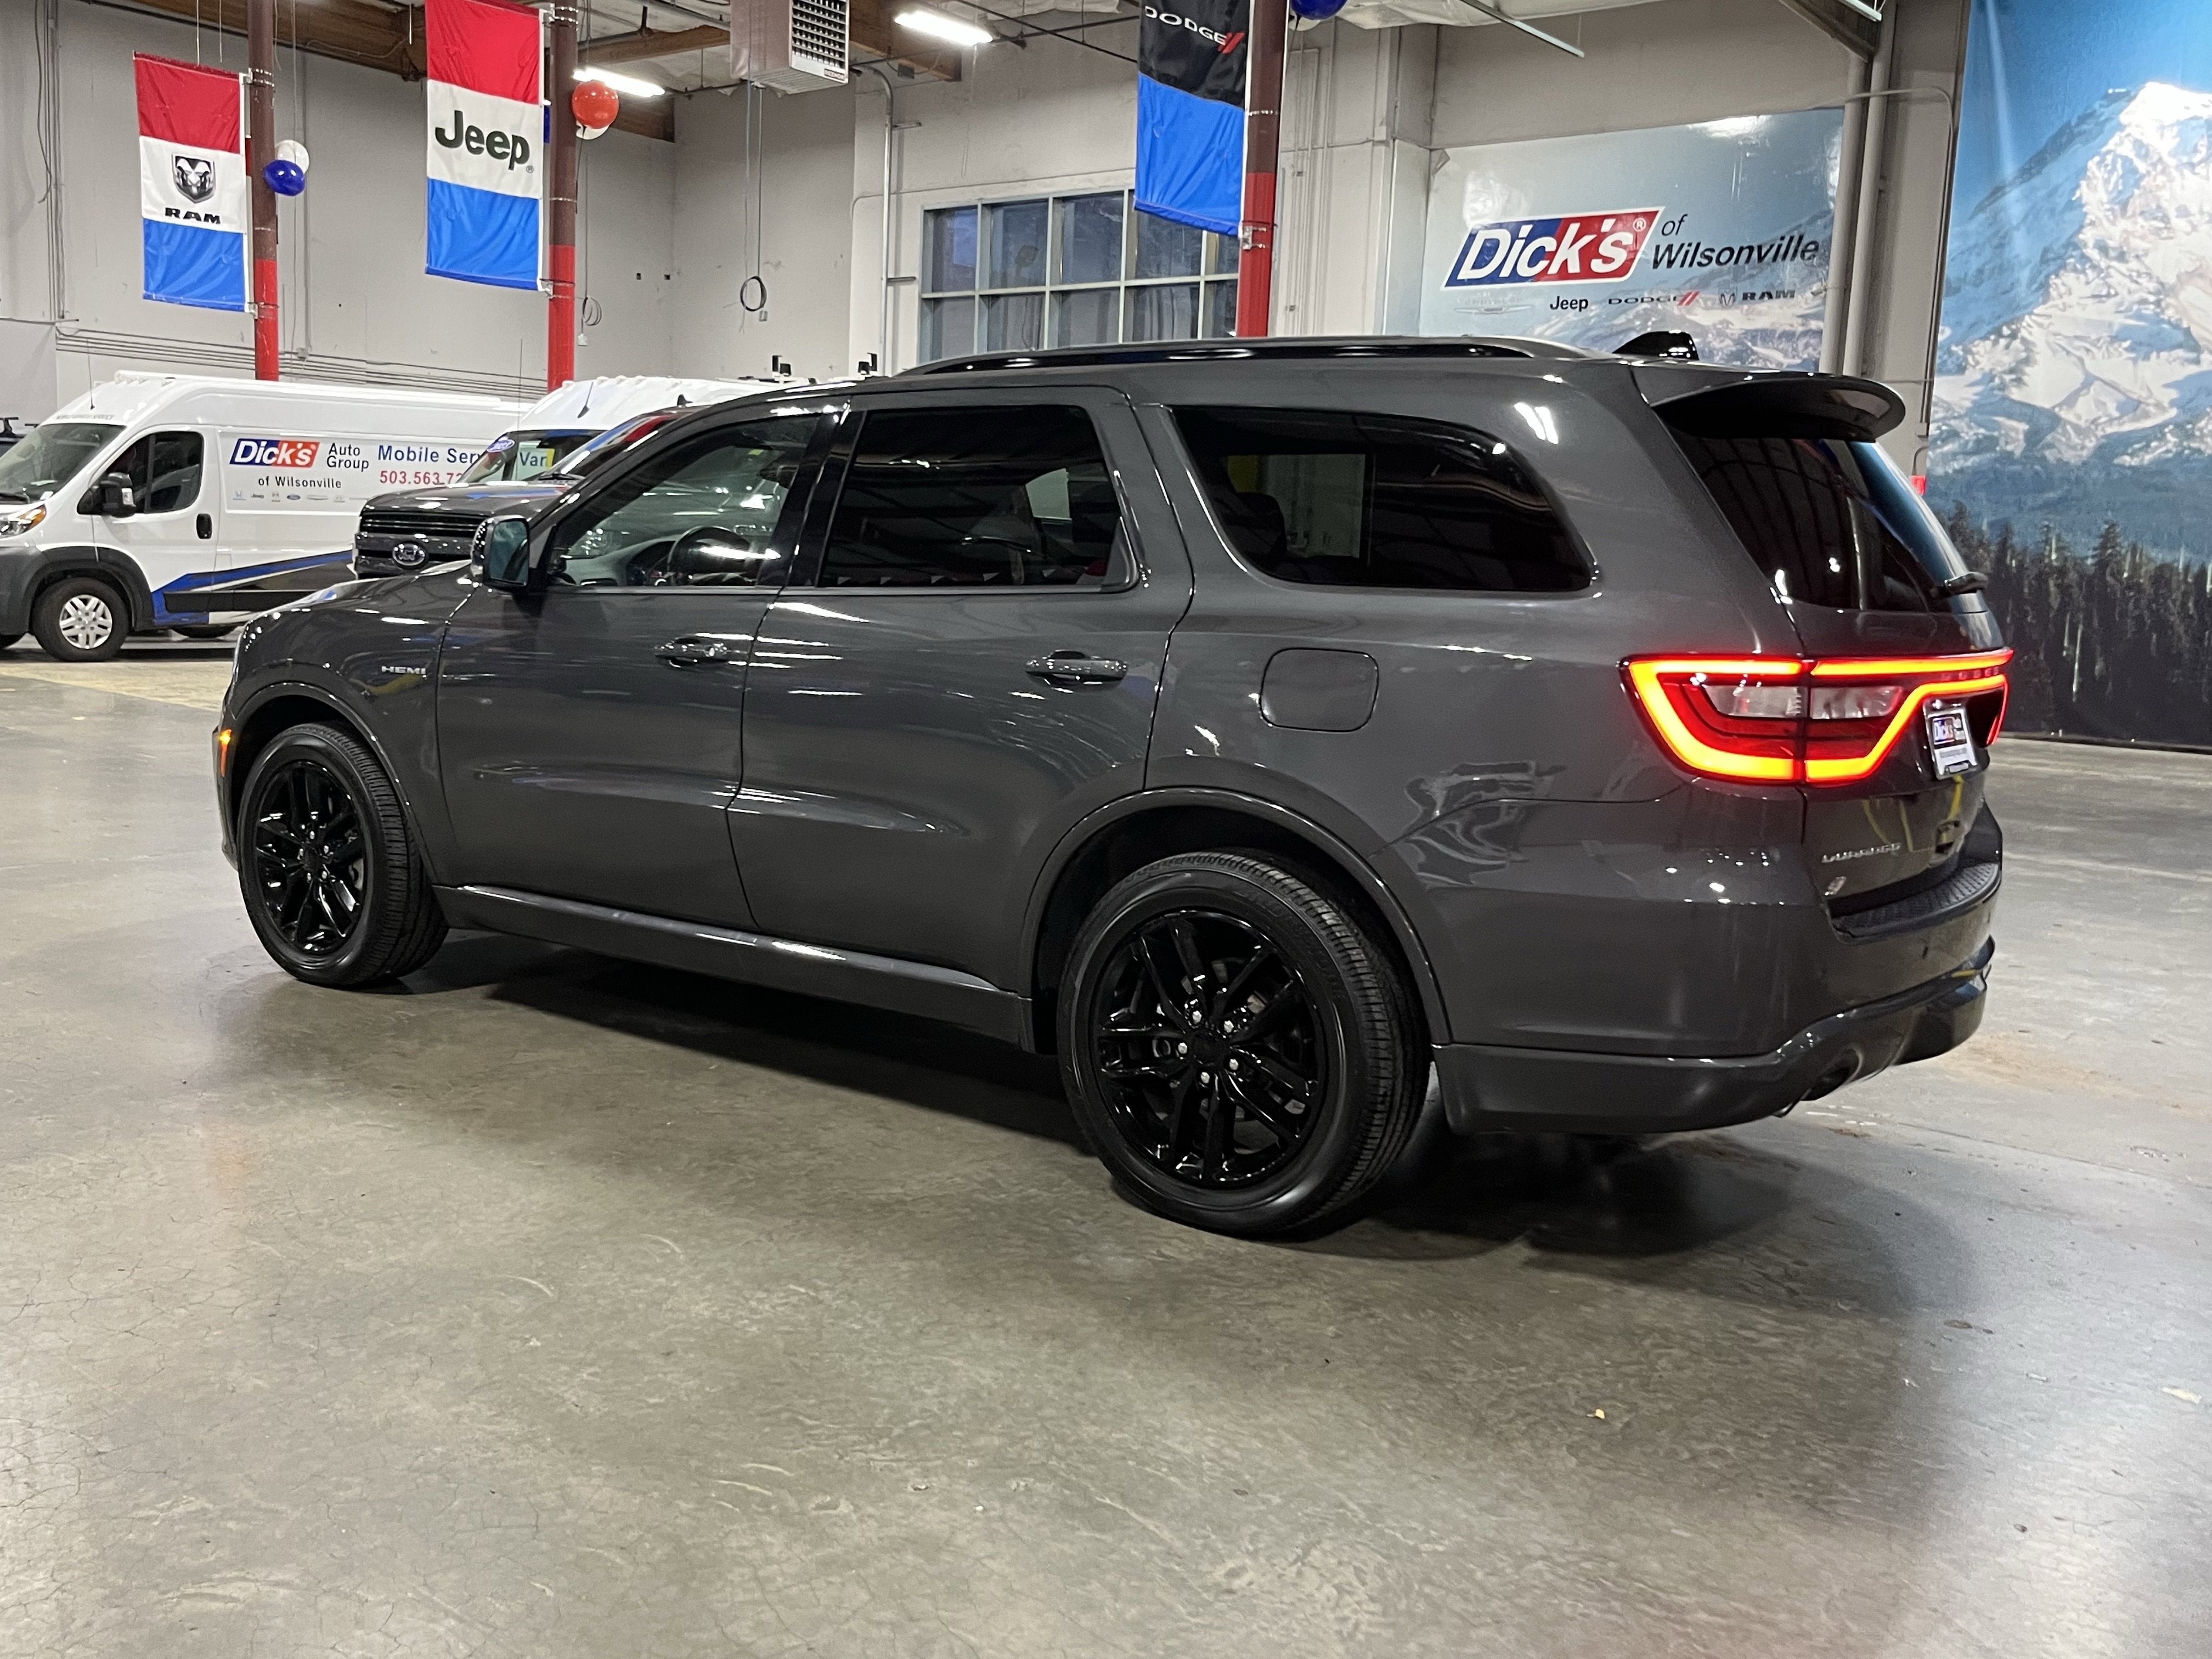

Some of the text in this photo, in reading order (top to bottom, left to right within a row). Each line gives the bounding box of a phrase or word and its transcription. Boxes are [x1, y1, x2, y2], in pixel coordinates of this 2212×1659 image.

[1145, 5, 1227, 46] DODGE
[435, 110, 530, 171] Jeep
[165, 207, 221, 225] RAM
[1457, 214, 1688, 280] Dick's of
[1652, 233, 1819, 269] Wilsonville
[1550, 296, 1589, 312] Jeep
[1742, 290, 1795, 301] RAM
[234, 441, 313, 466] Dick's
[329, 443, 360, 456] Auto
[378, 445, 439, 462] Mobile
[326, 455, 369, 472] Group
[258, 476, 342, 488] of Wilsonville
